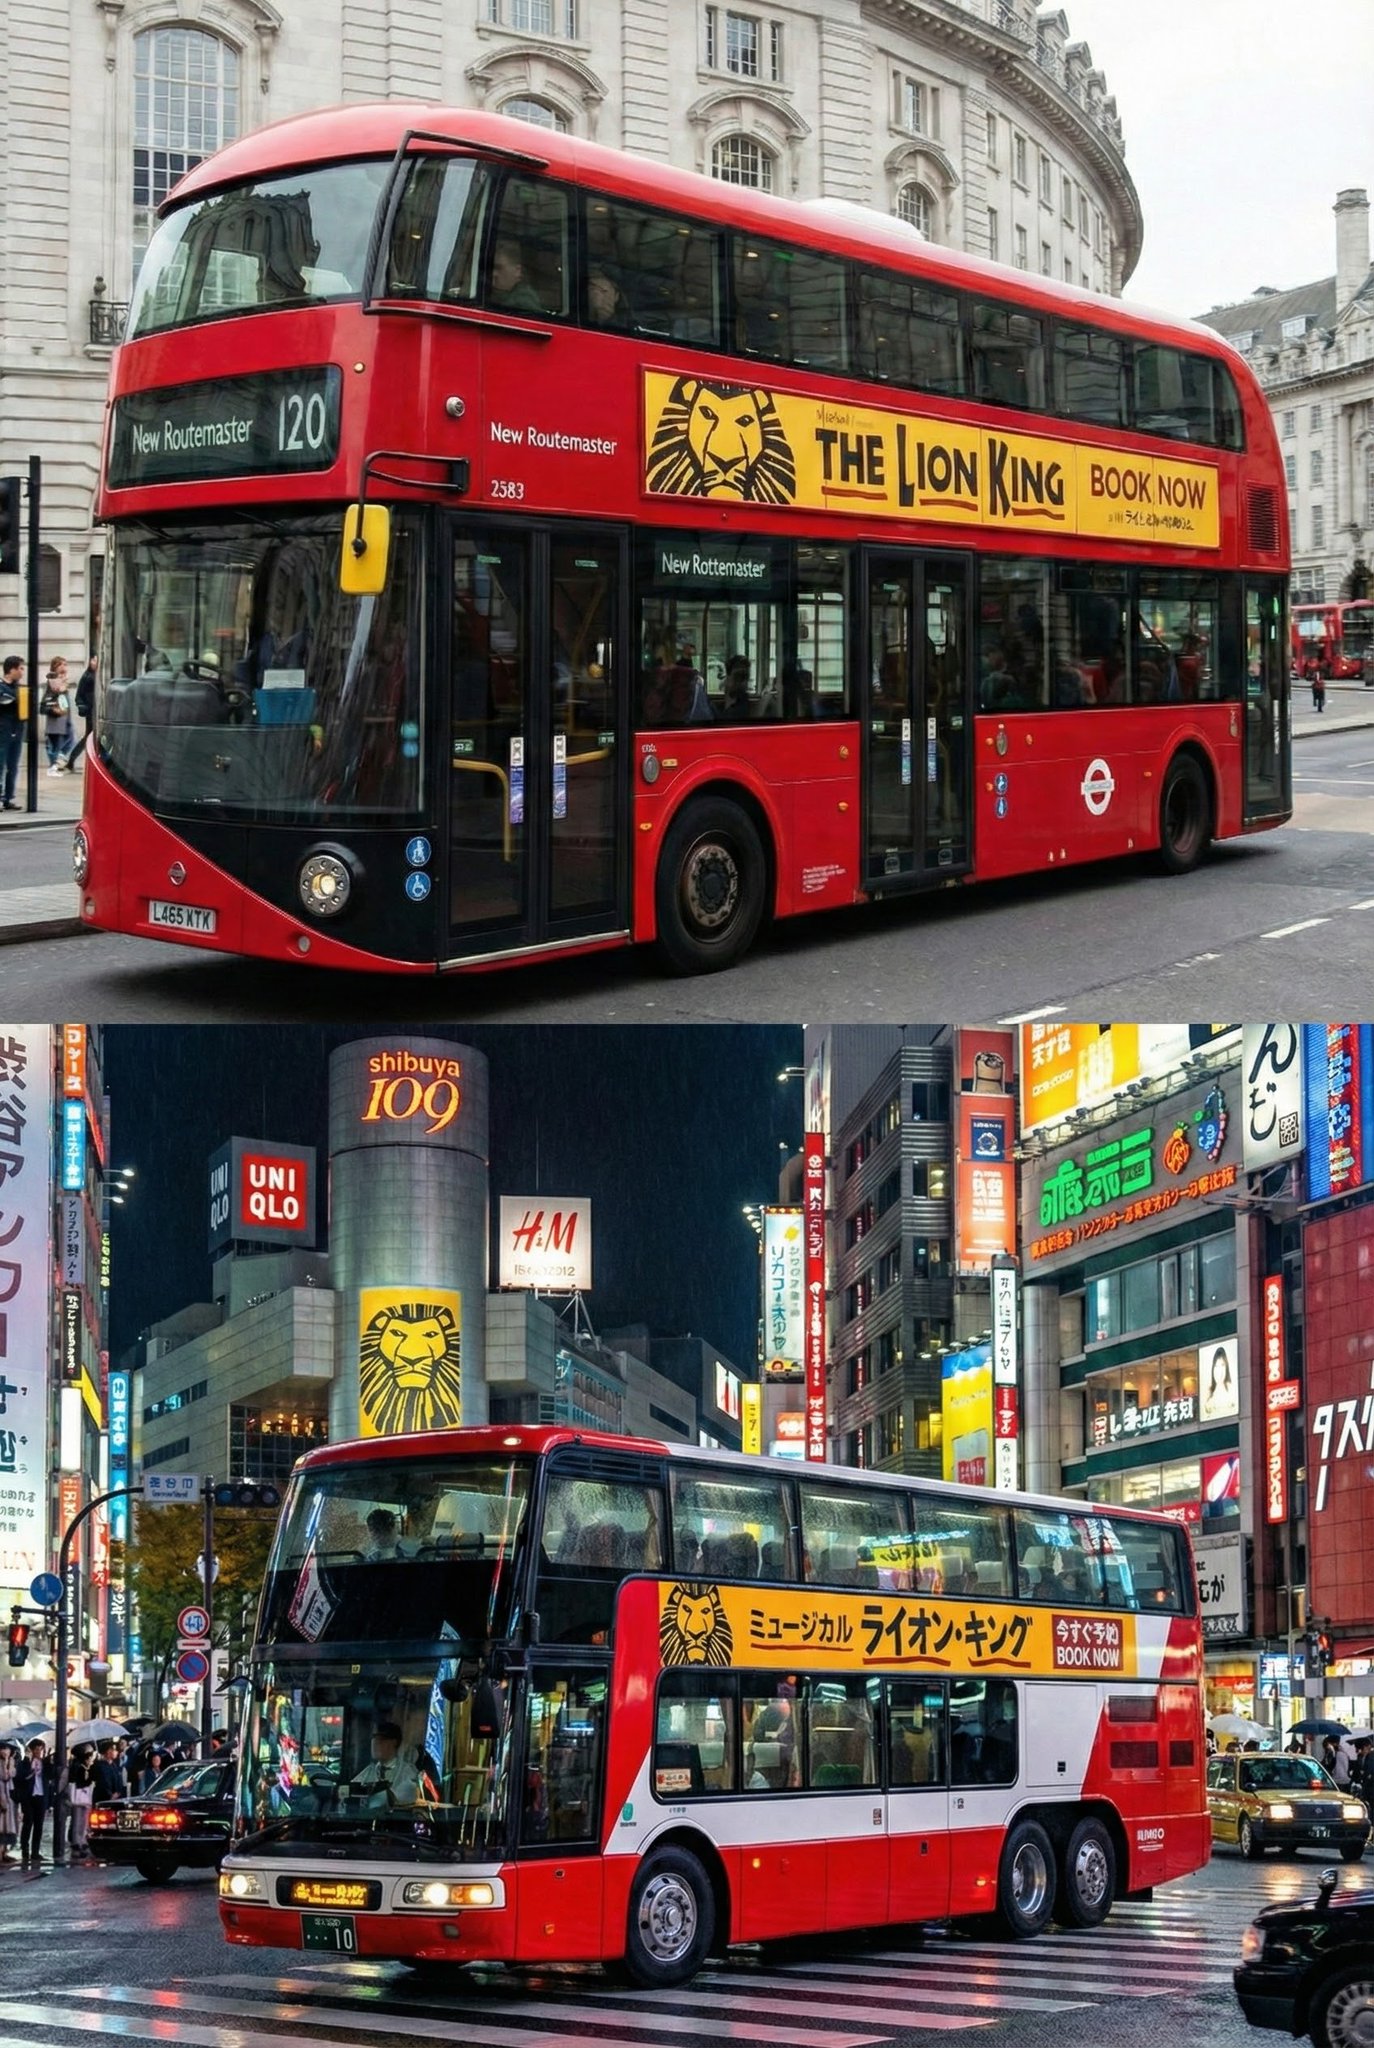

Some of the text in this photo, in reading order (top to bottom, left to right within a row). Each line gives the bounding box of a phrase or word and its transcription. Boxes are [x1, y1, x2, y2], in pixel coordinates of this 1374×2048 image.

[132, 416, 253, 455] New Routemaster
[278, 394, 327, 452] 120
[490, 421, 618, 455] New Routemaster
[815, 423, 1066, 519] THE LION KING
[1091, 463, 1207, 511] BOOK NOW
[490, 479, 525, 500] 2583
[661, 551, 690, 575] New
[153, 902, 184, 925] L465
[369, 1051, 461, 1078] shibuya
[361, 1076, 461, 1135] 109
[210, 1161, 229, 1194] UNI
[249, 1163, 296, 1191] UNI
[210, 1195, 229, 1231] QLO
[249, 1192, 299, 1221] QLO
[750, 1605, 1033, 1658] ミュージカル ライオン・キング
[1056, 1646, 1120, 1668] BOOK NOW
